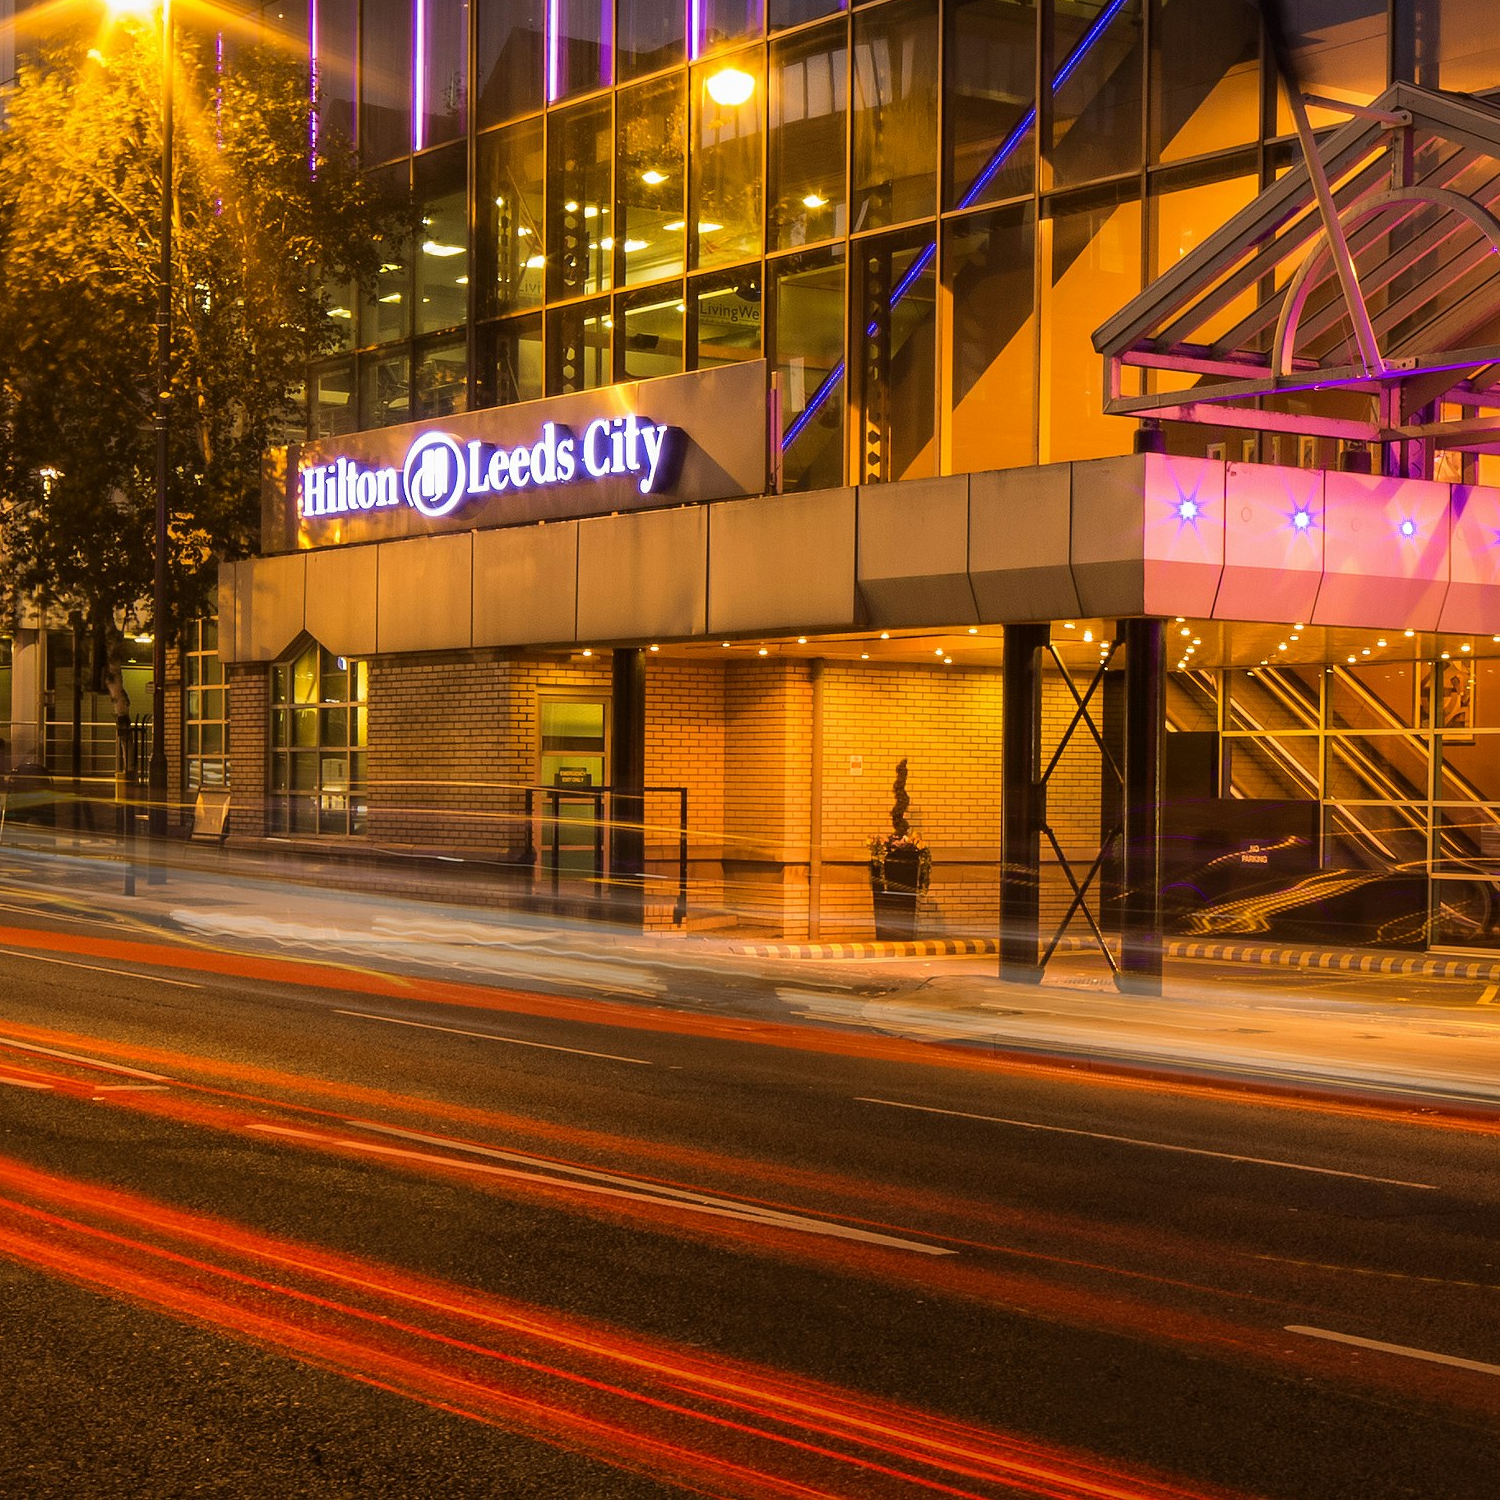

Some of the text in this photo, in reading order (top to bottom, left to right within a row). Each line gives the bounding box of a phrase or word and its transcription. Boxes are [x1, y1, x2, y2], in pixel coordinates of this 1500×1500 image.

[699, 300, 760, 322] LivingWe
[302, 413, 668, 517] Hilton Leeds City
[1241, 855, 1267, 863] PARKING
